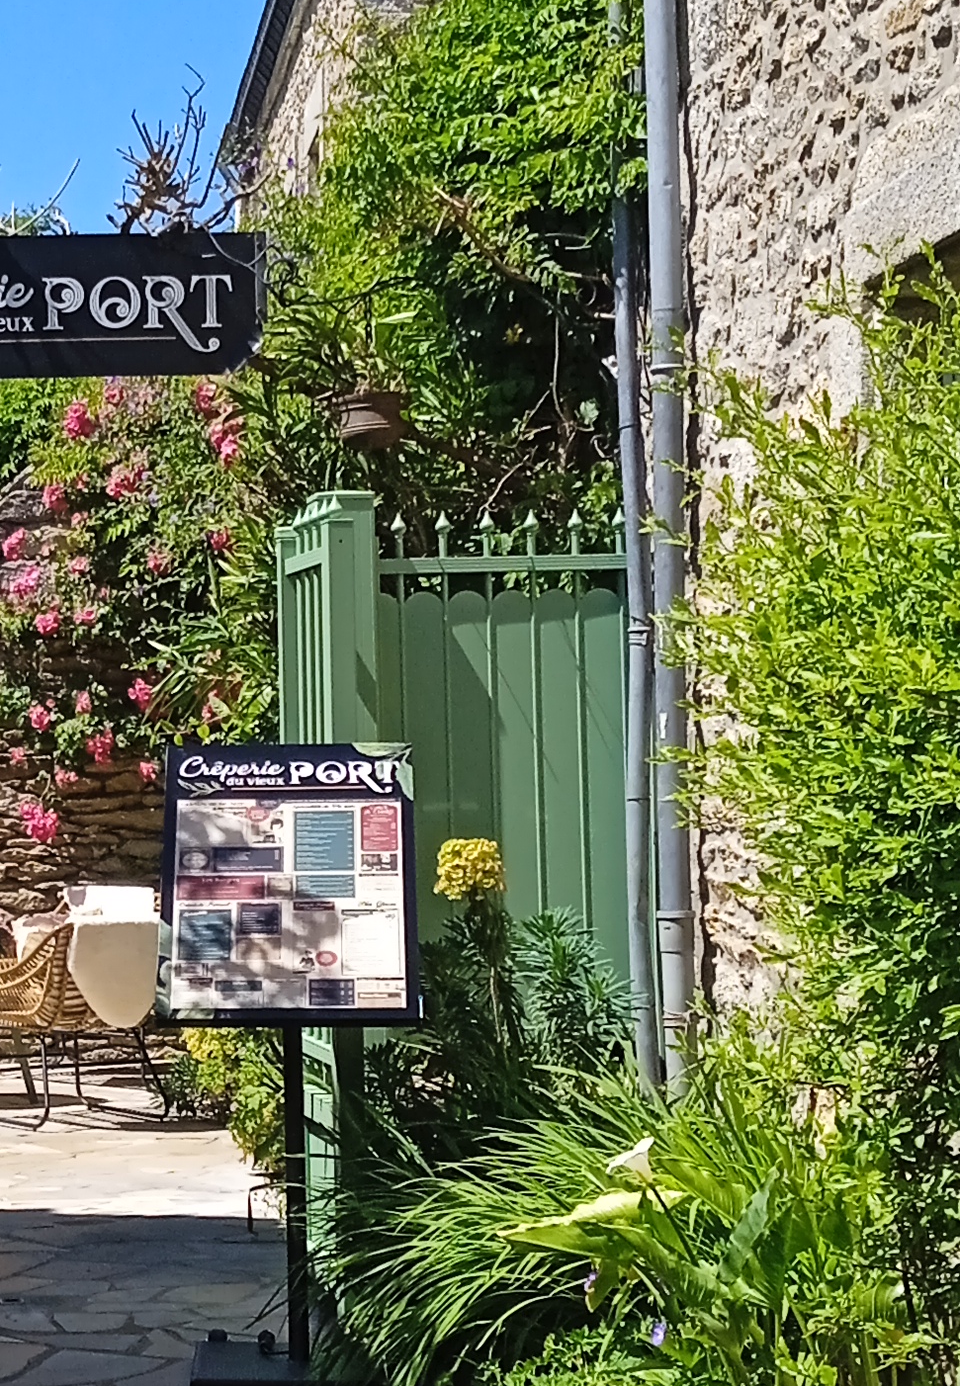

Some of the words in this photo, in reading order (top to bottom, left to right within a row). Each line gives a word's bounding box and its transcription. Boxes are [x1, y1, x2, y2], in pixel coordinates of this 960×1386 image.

[42, 274, 233, 354] PORT
[179, 755, 286, 784] Crêperie
[226, 774, 241, 786] du
[243, 775, 286, 786] vieux
[288, 760, 401, 794] PORT
